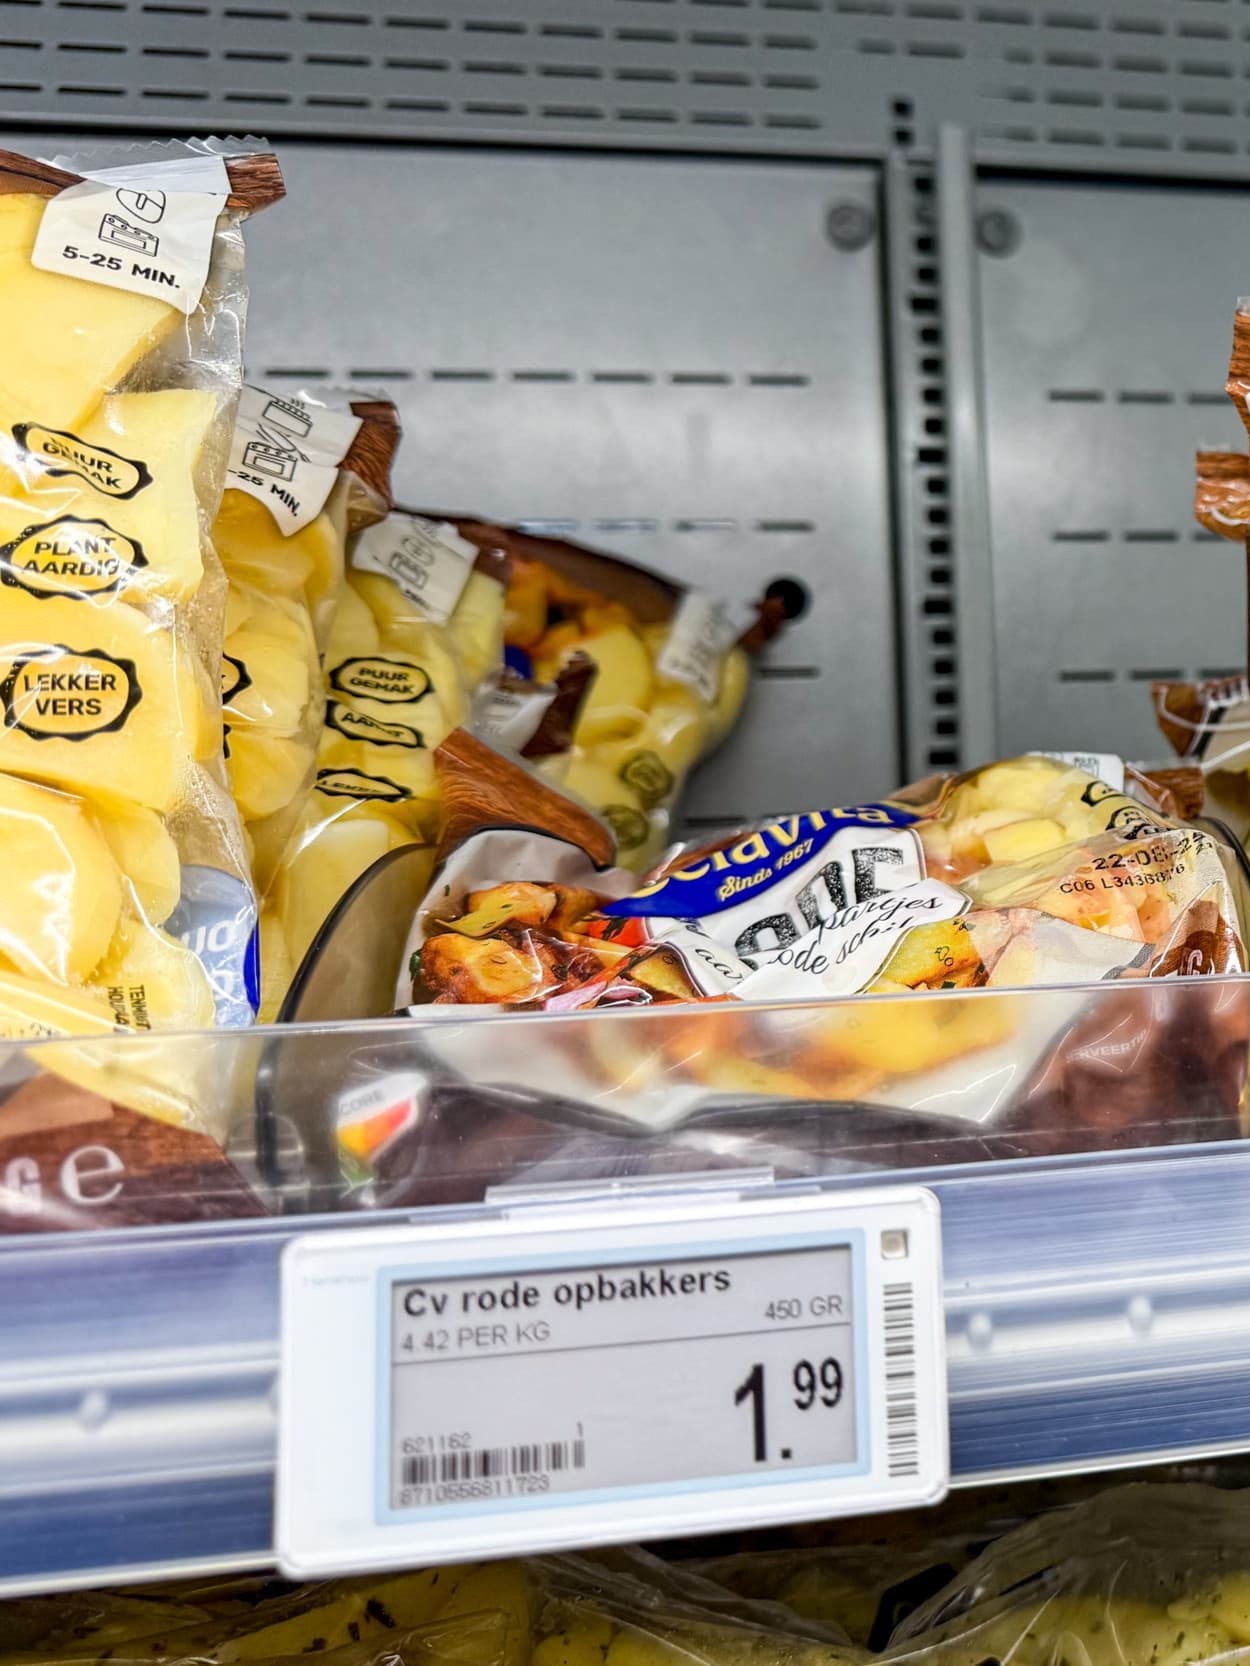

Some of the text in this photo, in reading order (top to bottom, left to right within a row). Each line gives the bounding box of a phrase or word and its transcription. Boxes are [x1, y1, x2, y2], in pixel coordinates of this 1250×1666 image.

[62, 245, 181, 289] 5-25 MIN.
[227, 469, 300, 517] -25 MIN.
[34, 536, 117, 556] PLANT
[23, 558, 119, 577] AARDIG
[24, 673, 117, 692] LEKKER
[349, 677, 415, 694] GEMAK
[359, 667, 409, 681] PUUR
[35, 698, 102, 716] VERS
[718, 838, 814, 900] Sinds 1967
[1060, 881, 1095, 894] C06
[767, 941, 829, 975] ode
[404, 1267, 731, 1318] Cv rode opbakkers
[764, 1295, 843, 1321] 450 GR
[402, 1320, 551, 1353] 4.42 PER KG
[793, 1357, 844, 1411] 99
[402, 1432, 472, 1454] 621162
